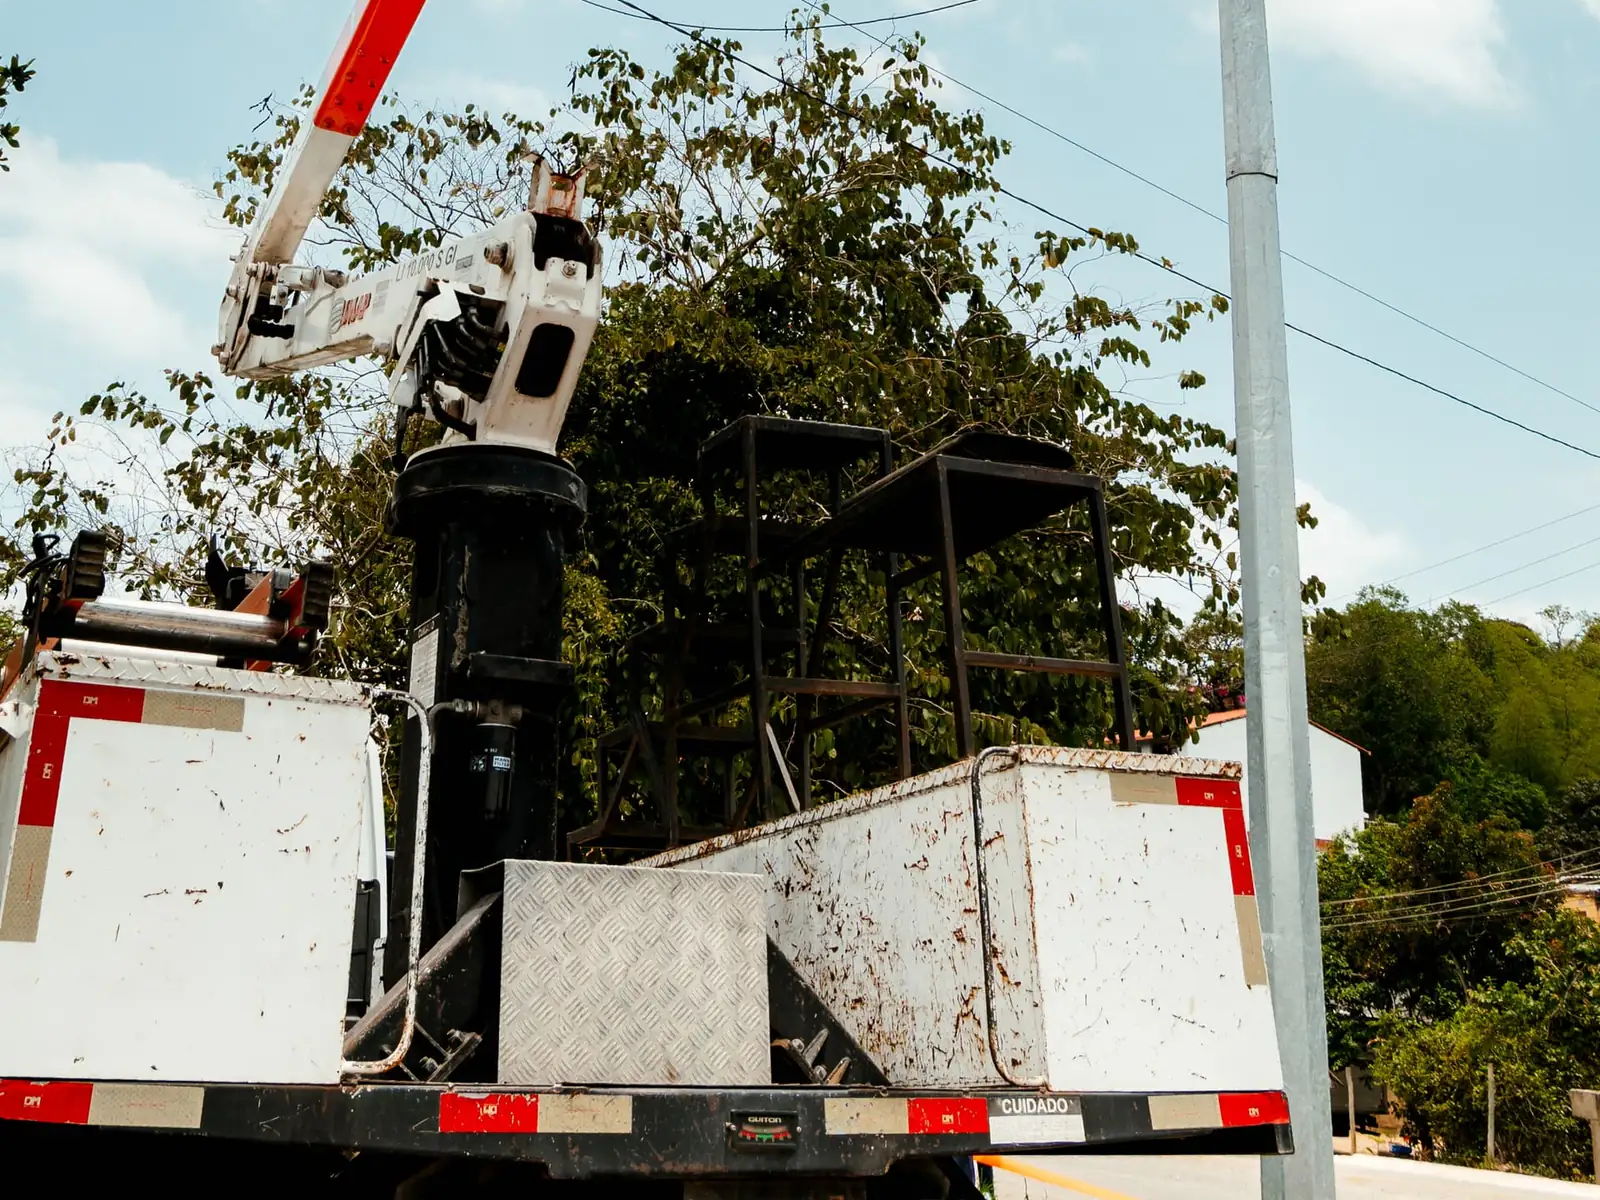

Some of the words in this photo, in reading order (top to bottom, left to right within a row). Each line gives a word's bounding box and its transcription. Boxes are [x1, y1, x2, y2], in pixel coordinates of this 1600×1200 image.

[435, 250, 444, 268] S
[445, 244, 458, 265] GI
[1002, 1098, 1068, 1113] CUIDADO
